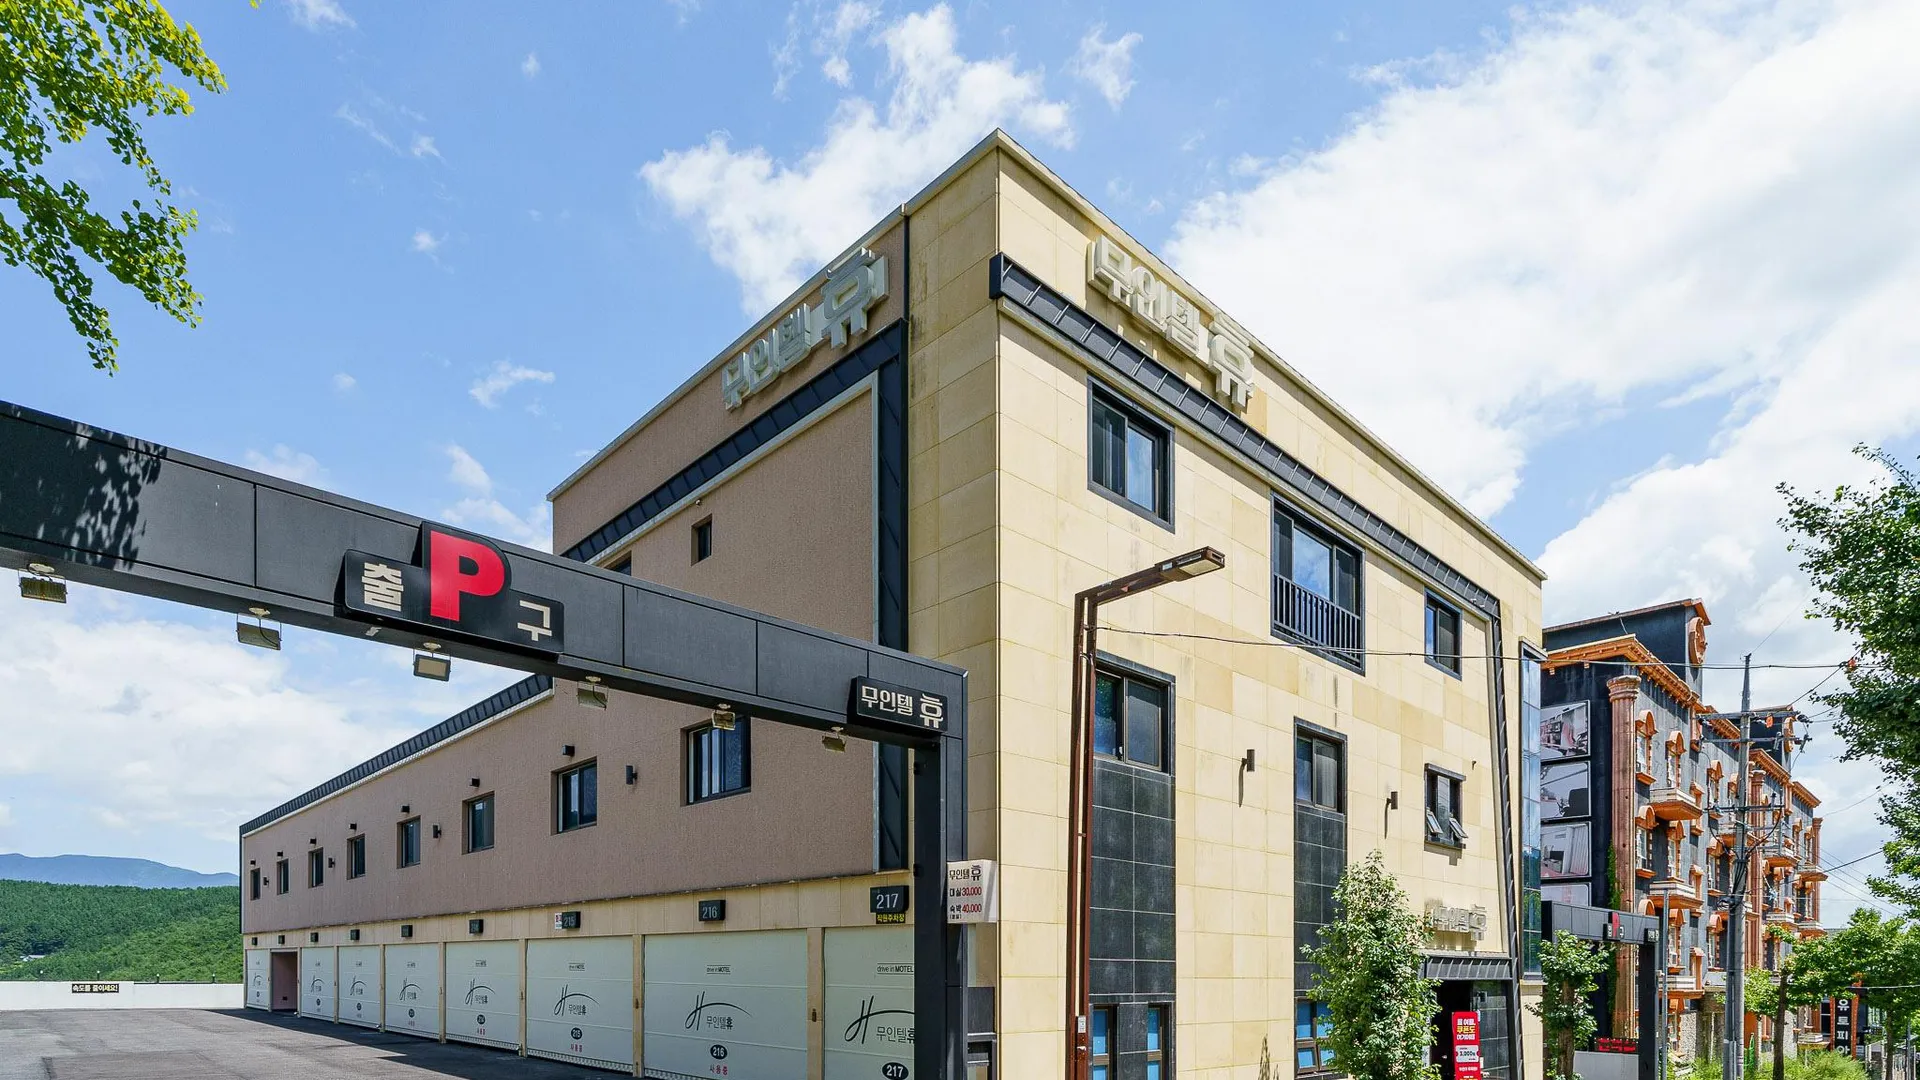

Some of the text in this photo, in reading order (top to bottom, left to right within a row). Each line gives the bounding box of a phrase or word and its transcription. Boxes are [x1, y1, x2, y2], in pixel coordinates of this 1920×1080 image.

[1094, 234, 1201, 358] 무인텔
[721, 247, 877, 413] 무인텔 휴
[361, 530, 553, 642] 출 P 구
[861, 685, 944, 729] 무인텔 휴
[949, 864, 982, 881] 무인텔 휴
[876, 893, 899, 909] 217
[702, 905, 718, 919] 216
[563, 915, 576, 927] 215
[877, 965, 889, 973] drive
[895, 965, 914, 973] MOTEL
[572, 1029, 581, 1039] 215
[712, 1046, 725, 1057] 216
[886, 1065, 904, 1078] 217
